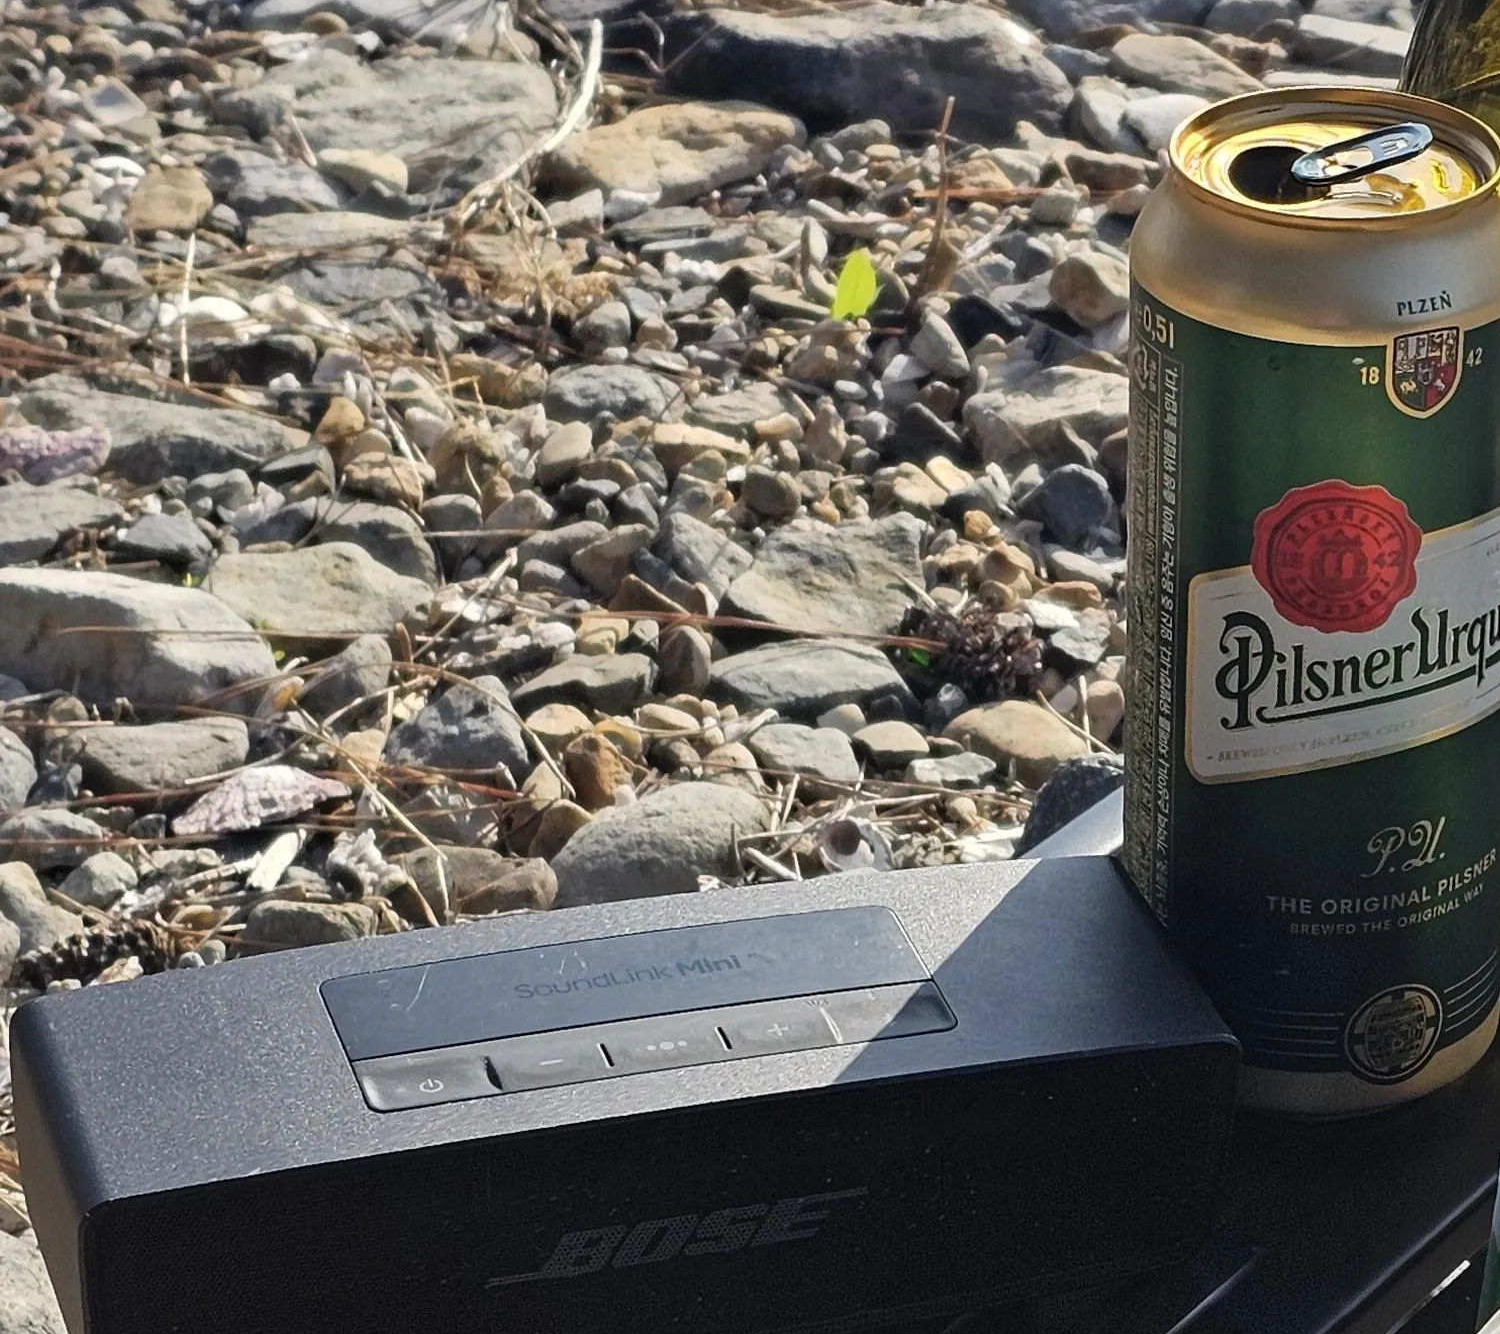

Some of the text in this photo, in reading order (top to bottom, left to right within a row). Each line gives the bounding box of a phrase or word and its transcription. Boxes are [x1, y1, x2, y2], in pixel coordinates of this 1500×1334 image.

[1396, 289, 1453, 317] PLZEŇ
[1359, 365, 1380, 387] 18
[1465, 349, 1483, 369] 42
[1161, 550, 1175, 594] 음주는
[1161, 593, 1174, 611] 중
[1160, 611, 1174, 642] 임신
[1215, 610, 1414, 731] Pilsner
[1266, 847, 1499, 916] THE ORIGINAL PILSNER
[1289, 881, 1486, 936] BREWED THE ORIGINAL WAY
[512, 966, 673, 1002] SoundLink
[676, 952, 743, 983] Mini
[500, 1189, 860, 1286] BOSE
